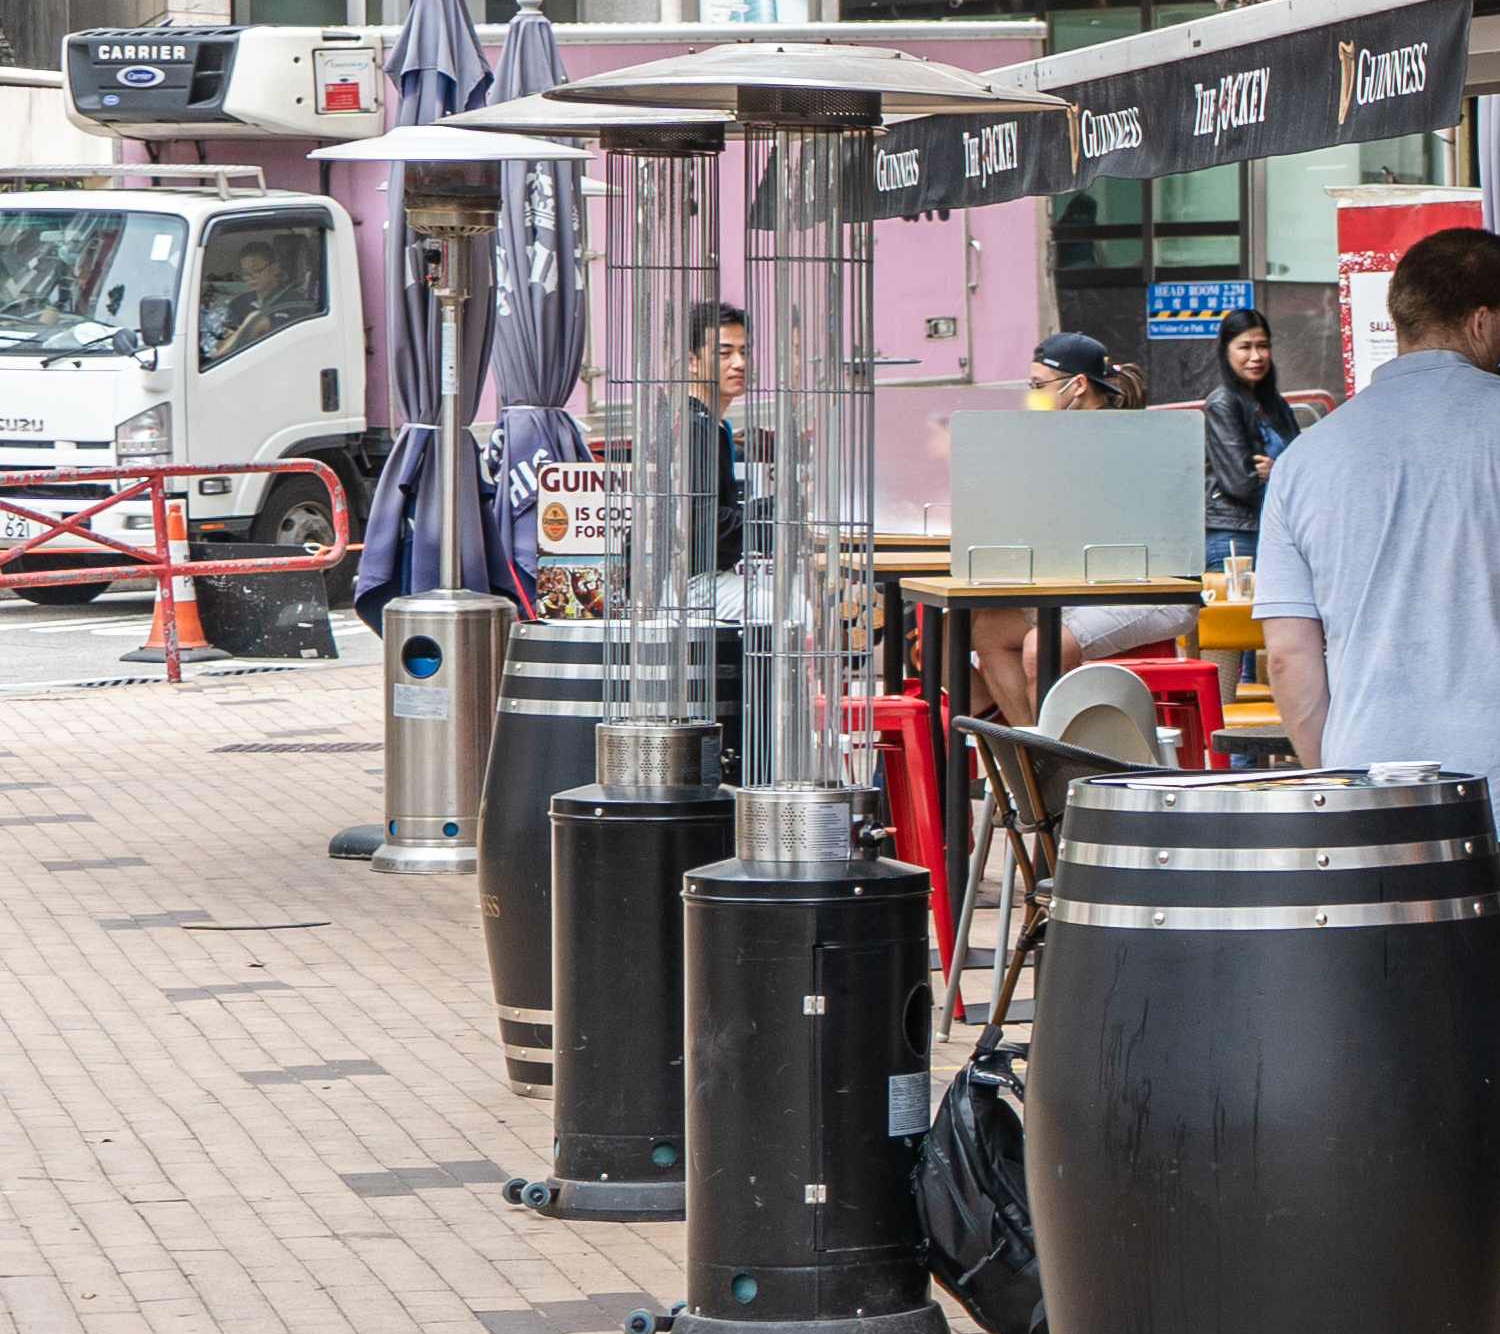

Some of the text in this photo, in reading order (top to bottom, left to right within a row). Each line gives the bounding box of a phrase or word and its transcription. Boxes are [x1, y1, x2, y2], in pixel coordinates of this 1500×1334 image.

[98, 44, 186, 61] CARRIER
[126, 70, 155, 83] Carrier
[963, 132, 981, 178] THE
[981, 120, 1018, 189] JOCKEY
[1081, 107, 1142, 159] GUINNESS
[1193, 82, 1216, 137] THE
[1214, 67, 1271, 146] JOCKEY
[1356, 42, 1428, 106] GUINNESS
[575, 507, 590, 521] IS
[5, 523, 30, 538] 621
